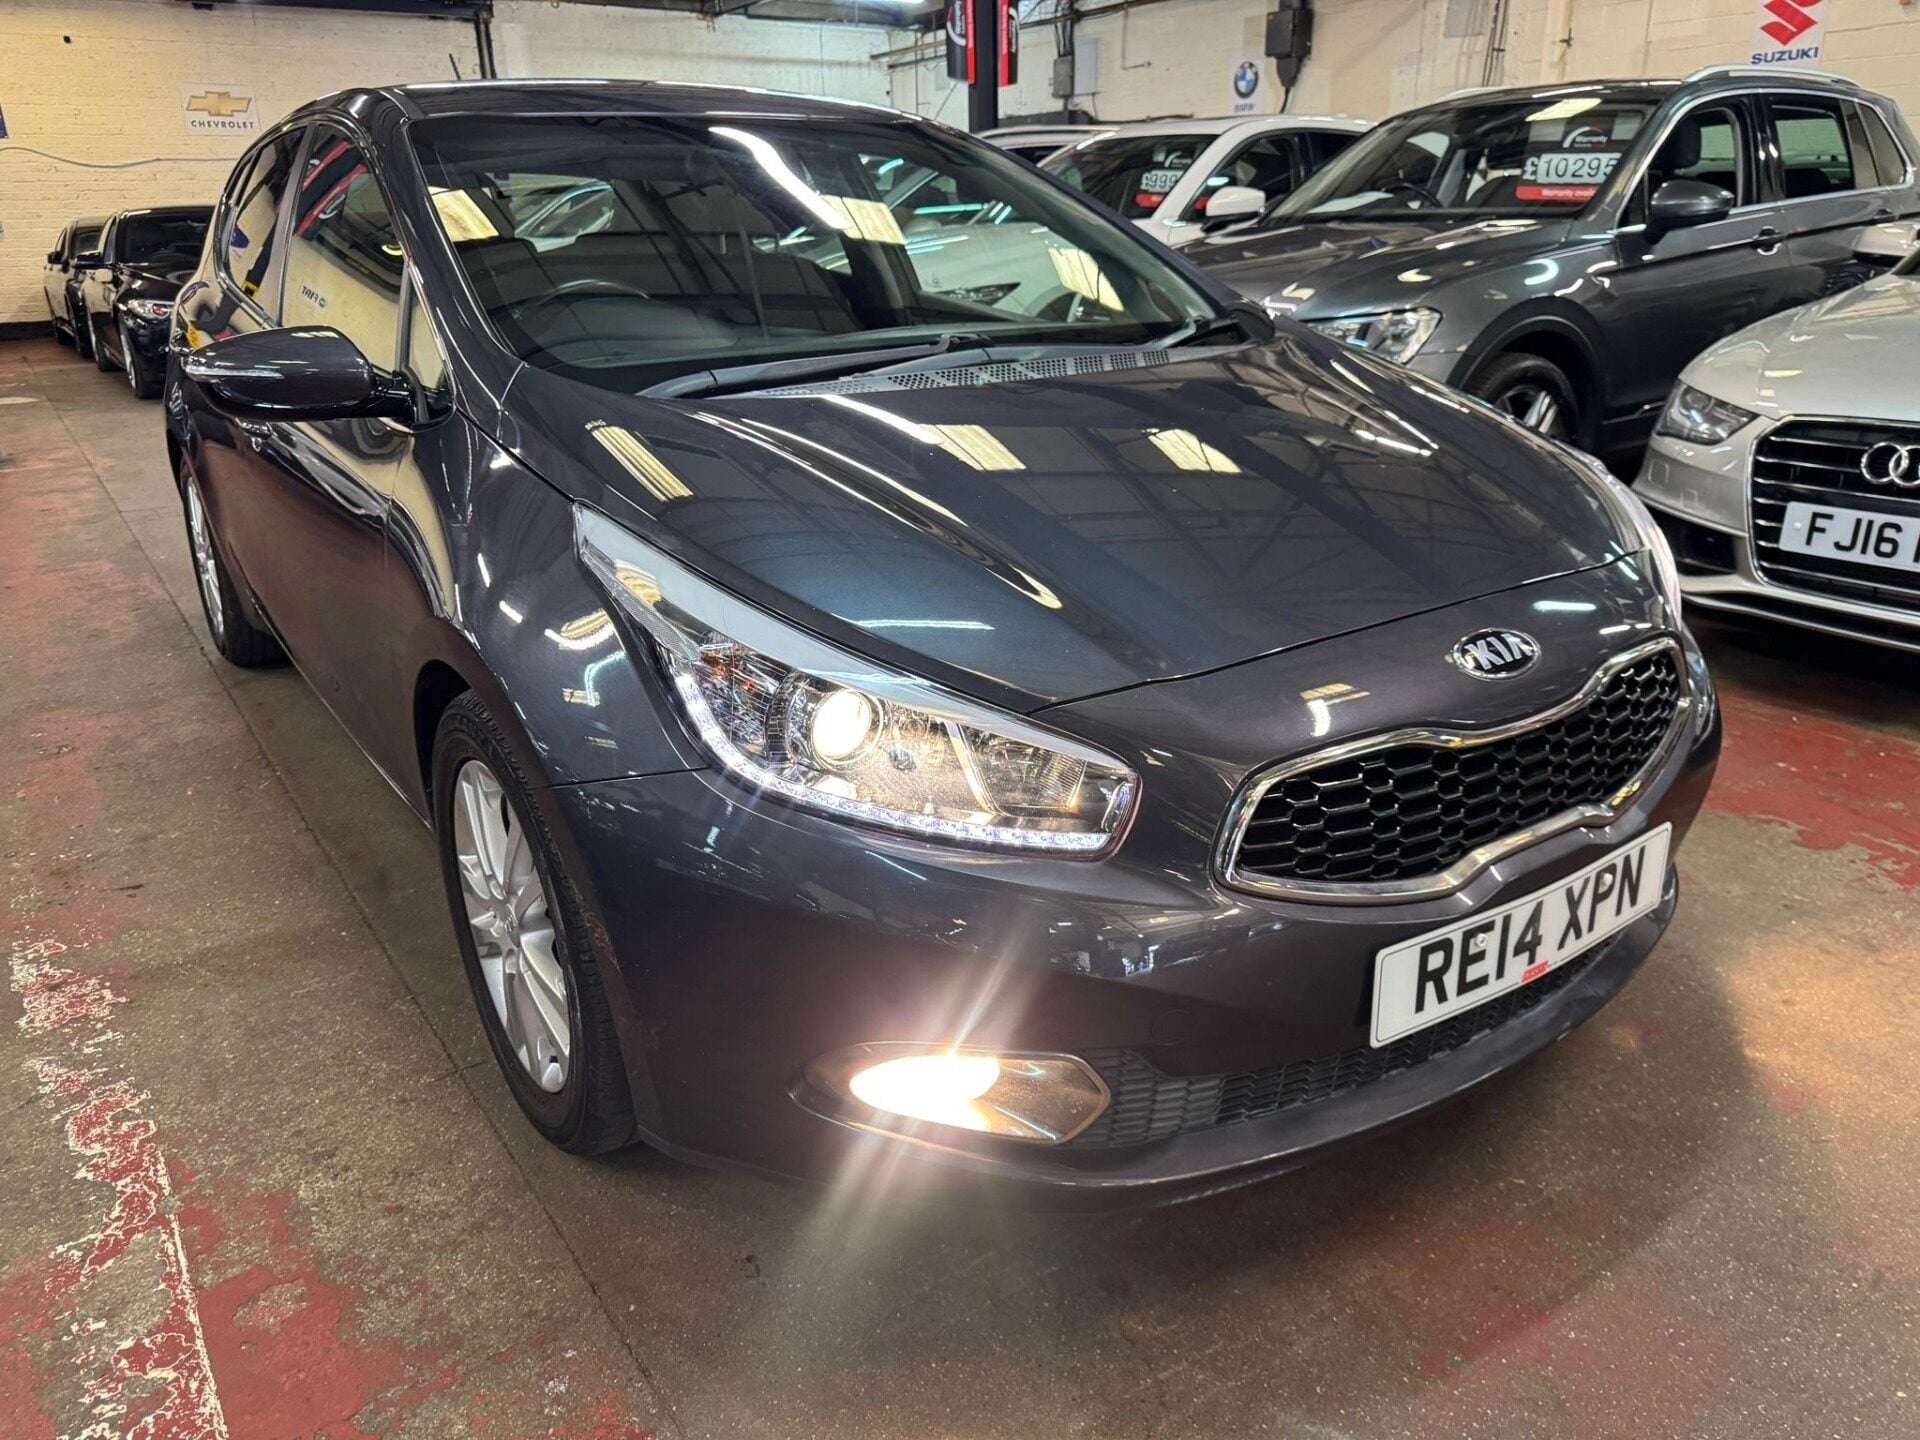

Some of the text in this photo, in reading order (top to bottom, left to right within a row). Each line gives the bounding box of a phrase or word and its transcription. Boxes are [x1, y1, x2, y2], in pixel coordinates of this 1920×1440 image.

[1751, 46, 1819, 64] SUZUKI
[191, 120, 254, 129] CHEVROLET
[1805, 511, 1903, 559] FJ16
[1463, 633, 1534, 670] KIA
[1414, 846, 1646, 1015] RE14 XPN
